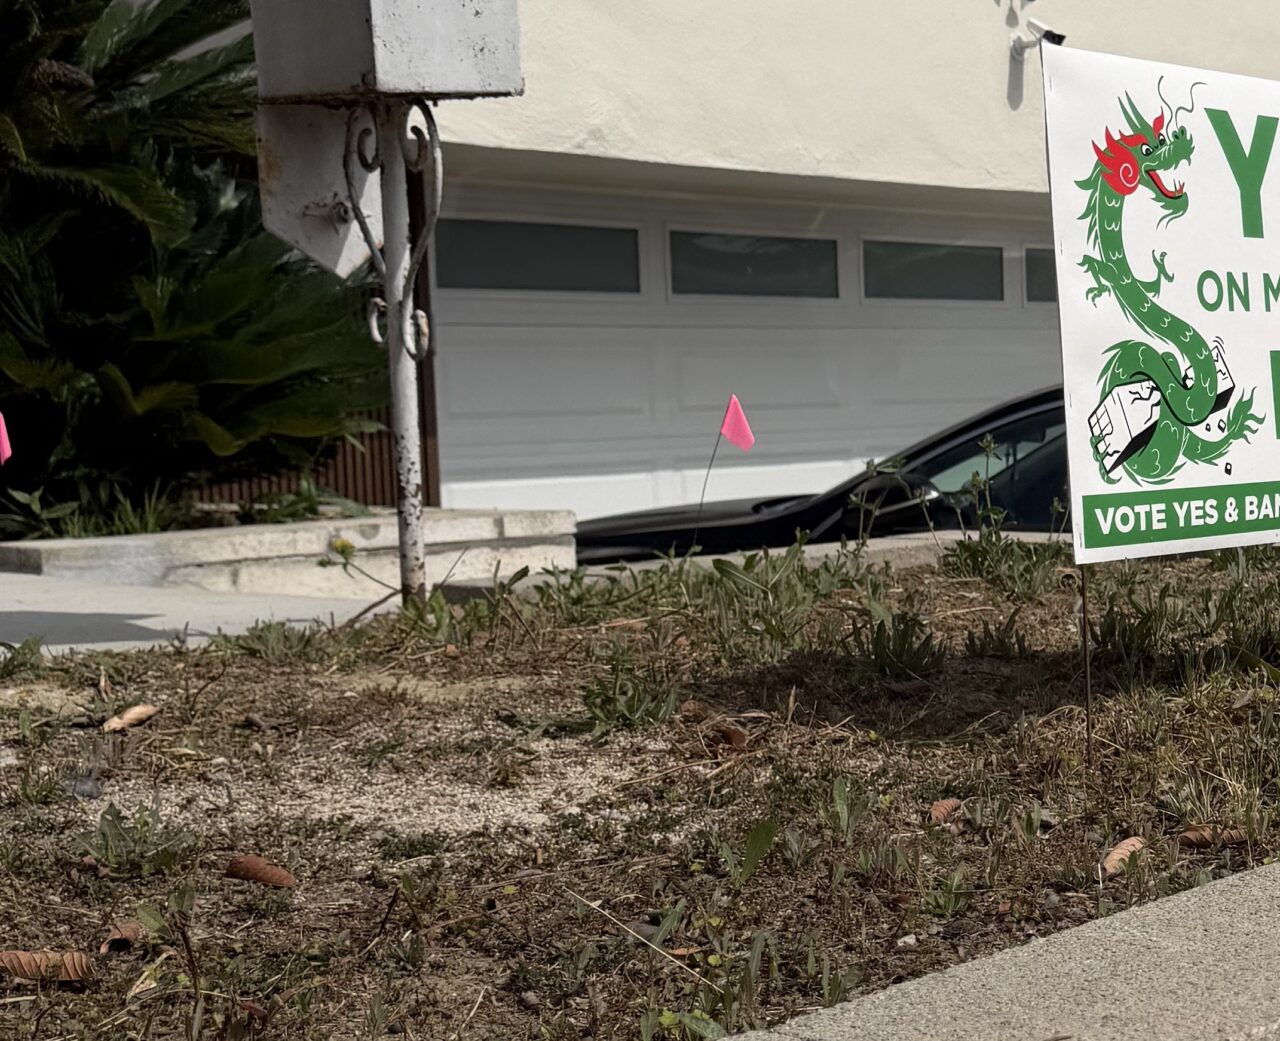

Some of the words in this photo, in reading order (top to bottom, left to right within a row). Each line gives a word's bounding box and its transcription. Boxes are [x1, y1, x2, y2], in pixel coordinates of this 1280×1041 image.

[1197, 270, 1251, 313] ON
[1094, 505, 1168, 535] VOTE
[1171, 498, 1219, 528] YES
[1223, 496, 1239, 523] &
